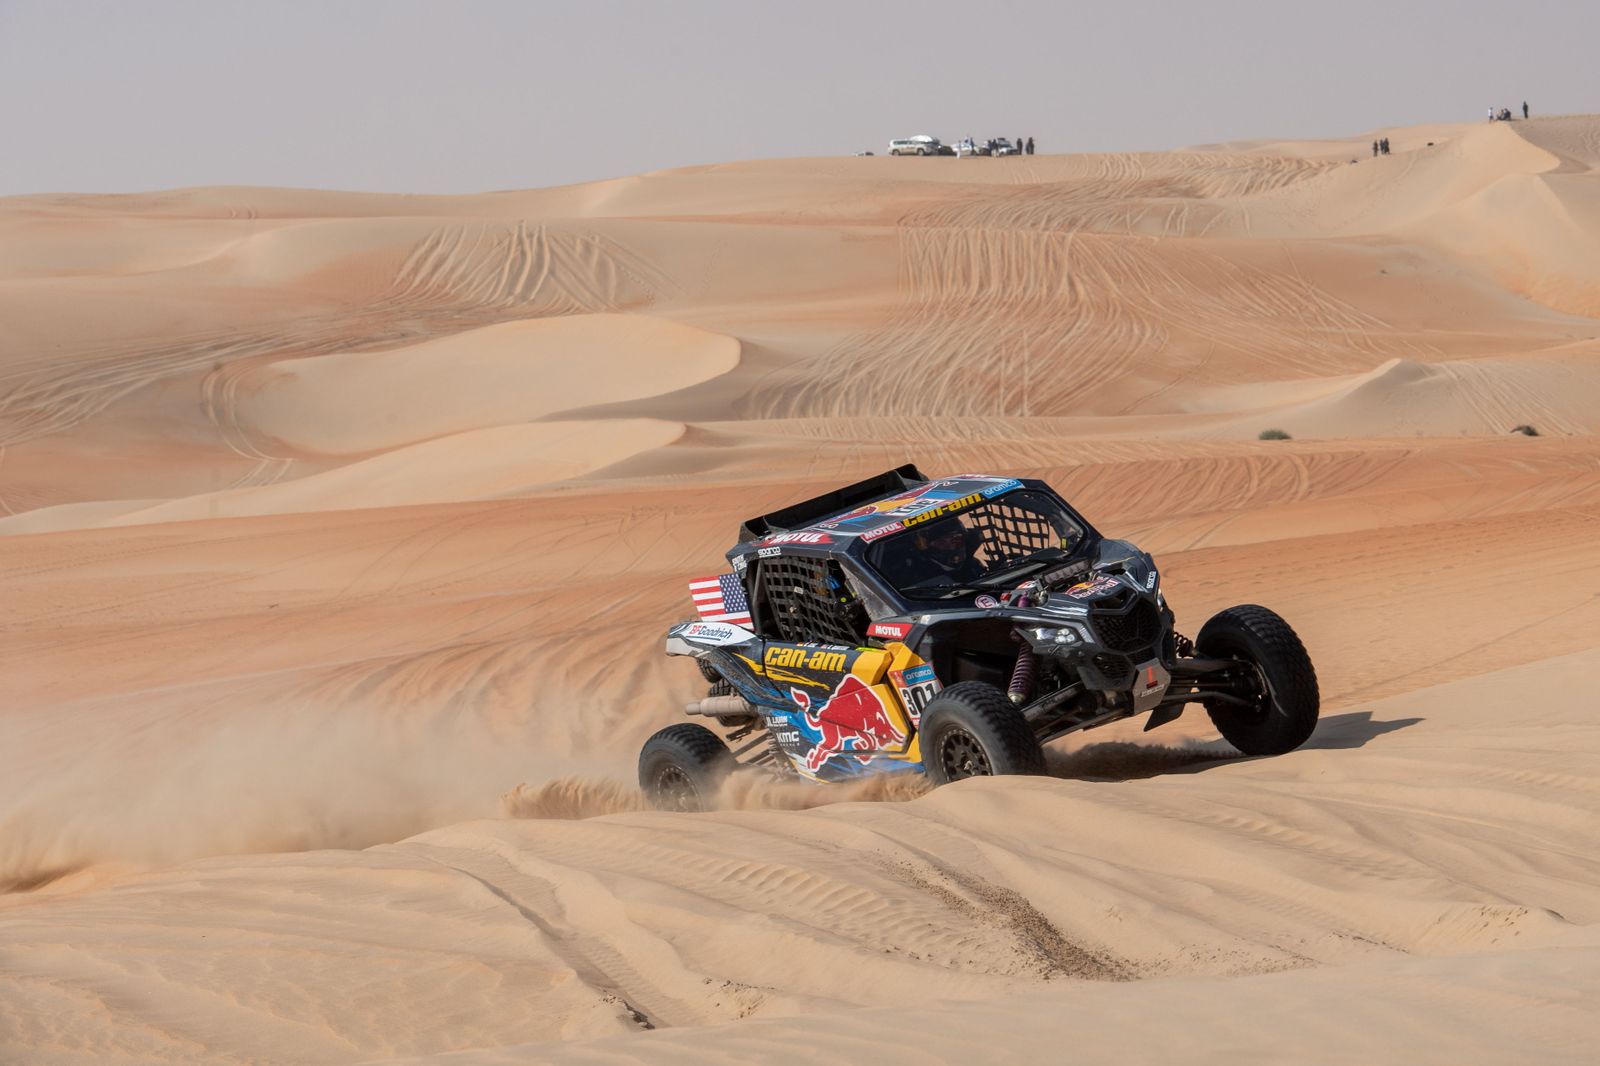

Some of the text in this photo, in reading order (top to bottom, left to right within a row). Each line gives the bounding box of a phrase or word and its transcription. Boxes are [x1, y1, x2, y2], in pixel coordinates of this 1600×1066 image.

[985, 479, 1017, 495] aramco
[902, 493, 982, 527] can-am
[865, 521, 902, 540] MOTUL
[688, 624, 733, 639] BFGoodrich
[875, 625, 902, 637] MOTUL
[764, 646, 848, 672] can-am
[905, 668, 932, 681] aramco
